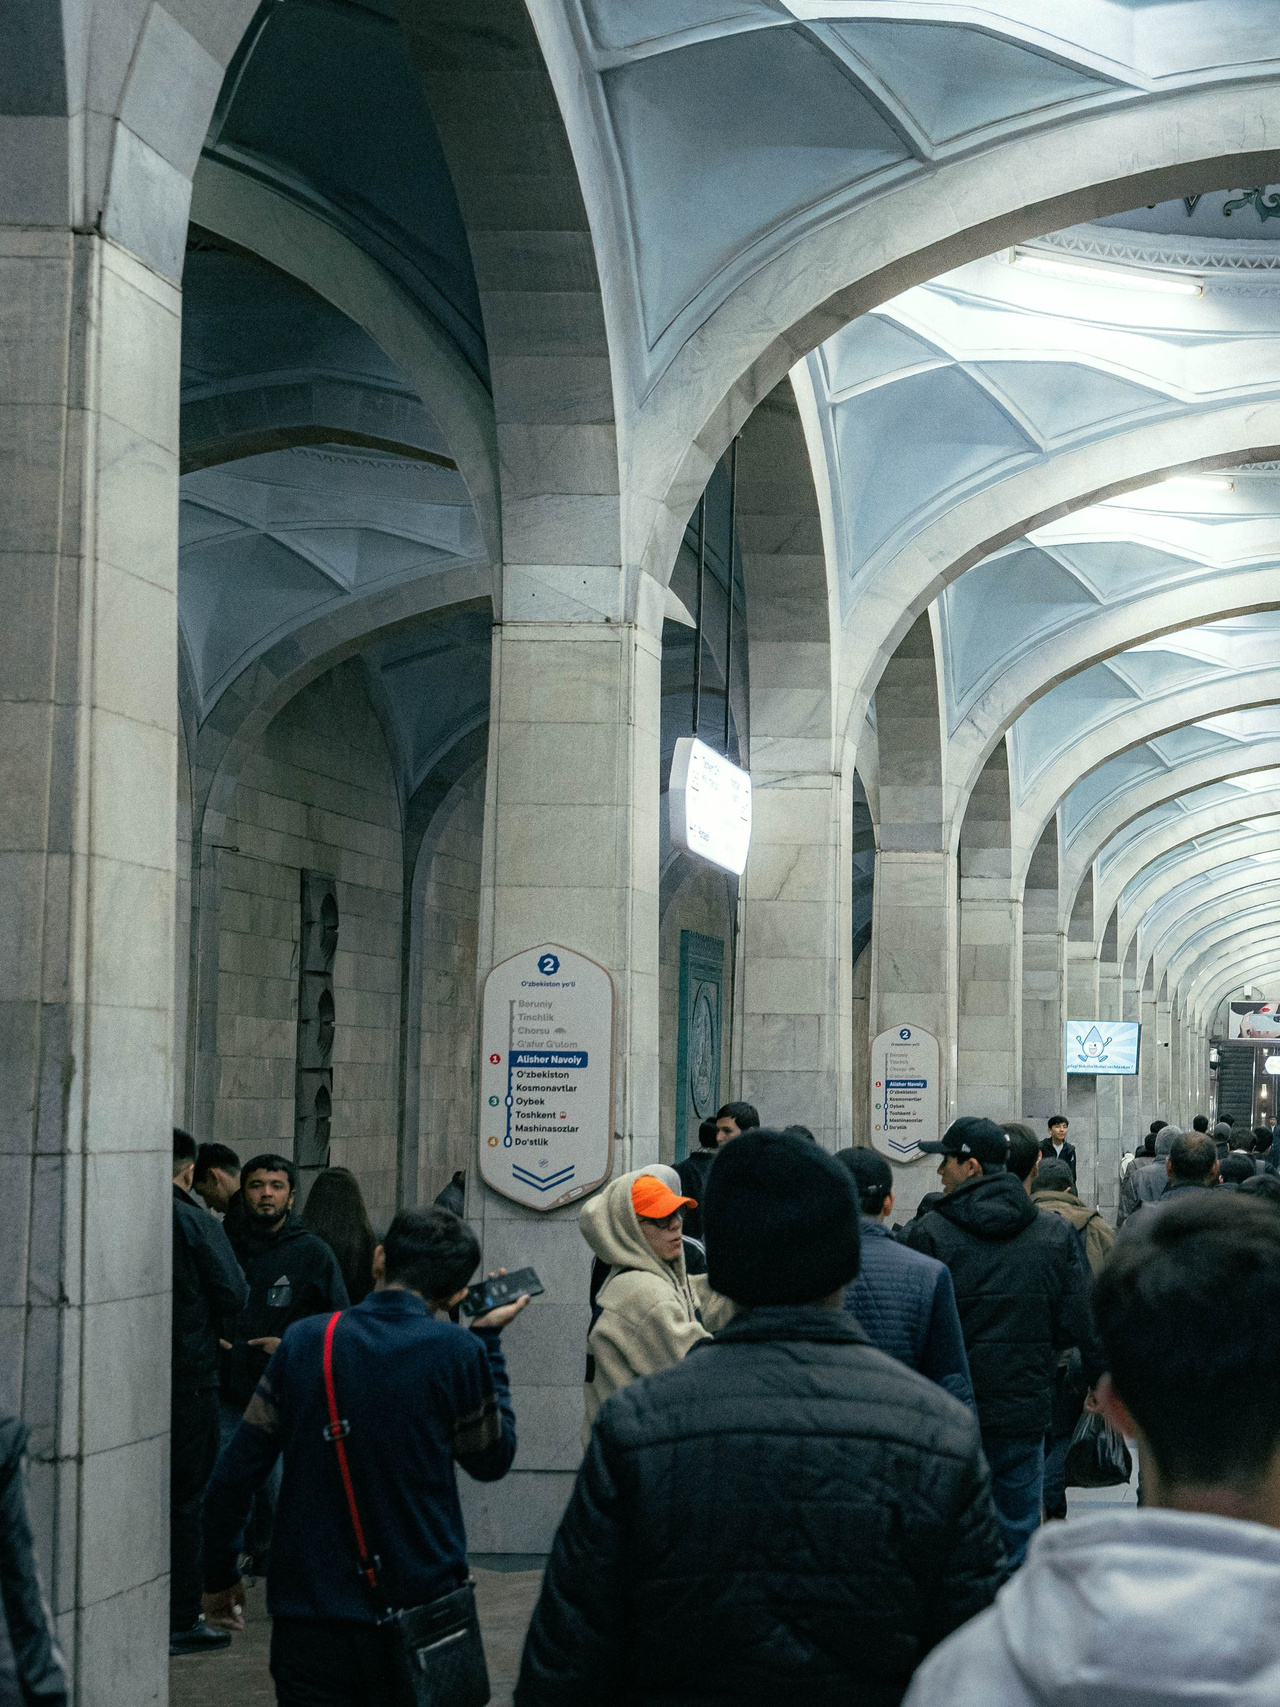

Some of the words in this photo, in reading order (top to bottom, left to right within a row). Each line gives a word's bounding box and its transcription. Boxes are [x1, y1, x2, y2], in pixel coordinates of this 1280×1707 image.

[543, 958, 554, 972] 2
[518, 1000, 553, 1009] Beruniy
[518, 1013, 554, 1021] Tinchlik
[902, 1030, 909, 1038] 2
[517, 1055, 549, 1064] Alisher
[551, 1055, 582, 1065] Navoiy
[516, 1084, 577, 1092] Kosmonavtlar
[516, 1097, 545, 1106] Oybek
[516, 1111, 556, 1119] Toshkent
